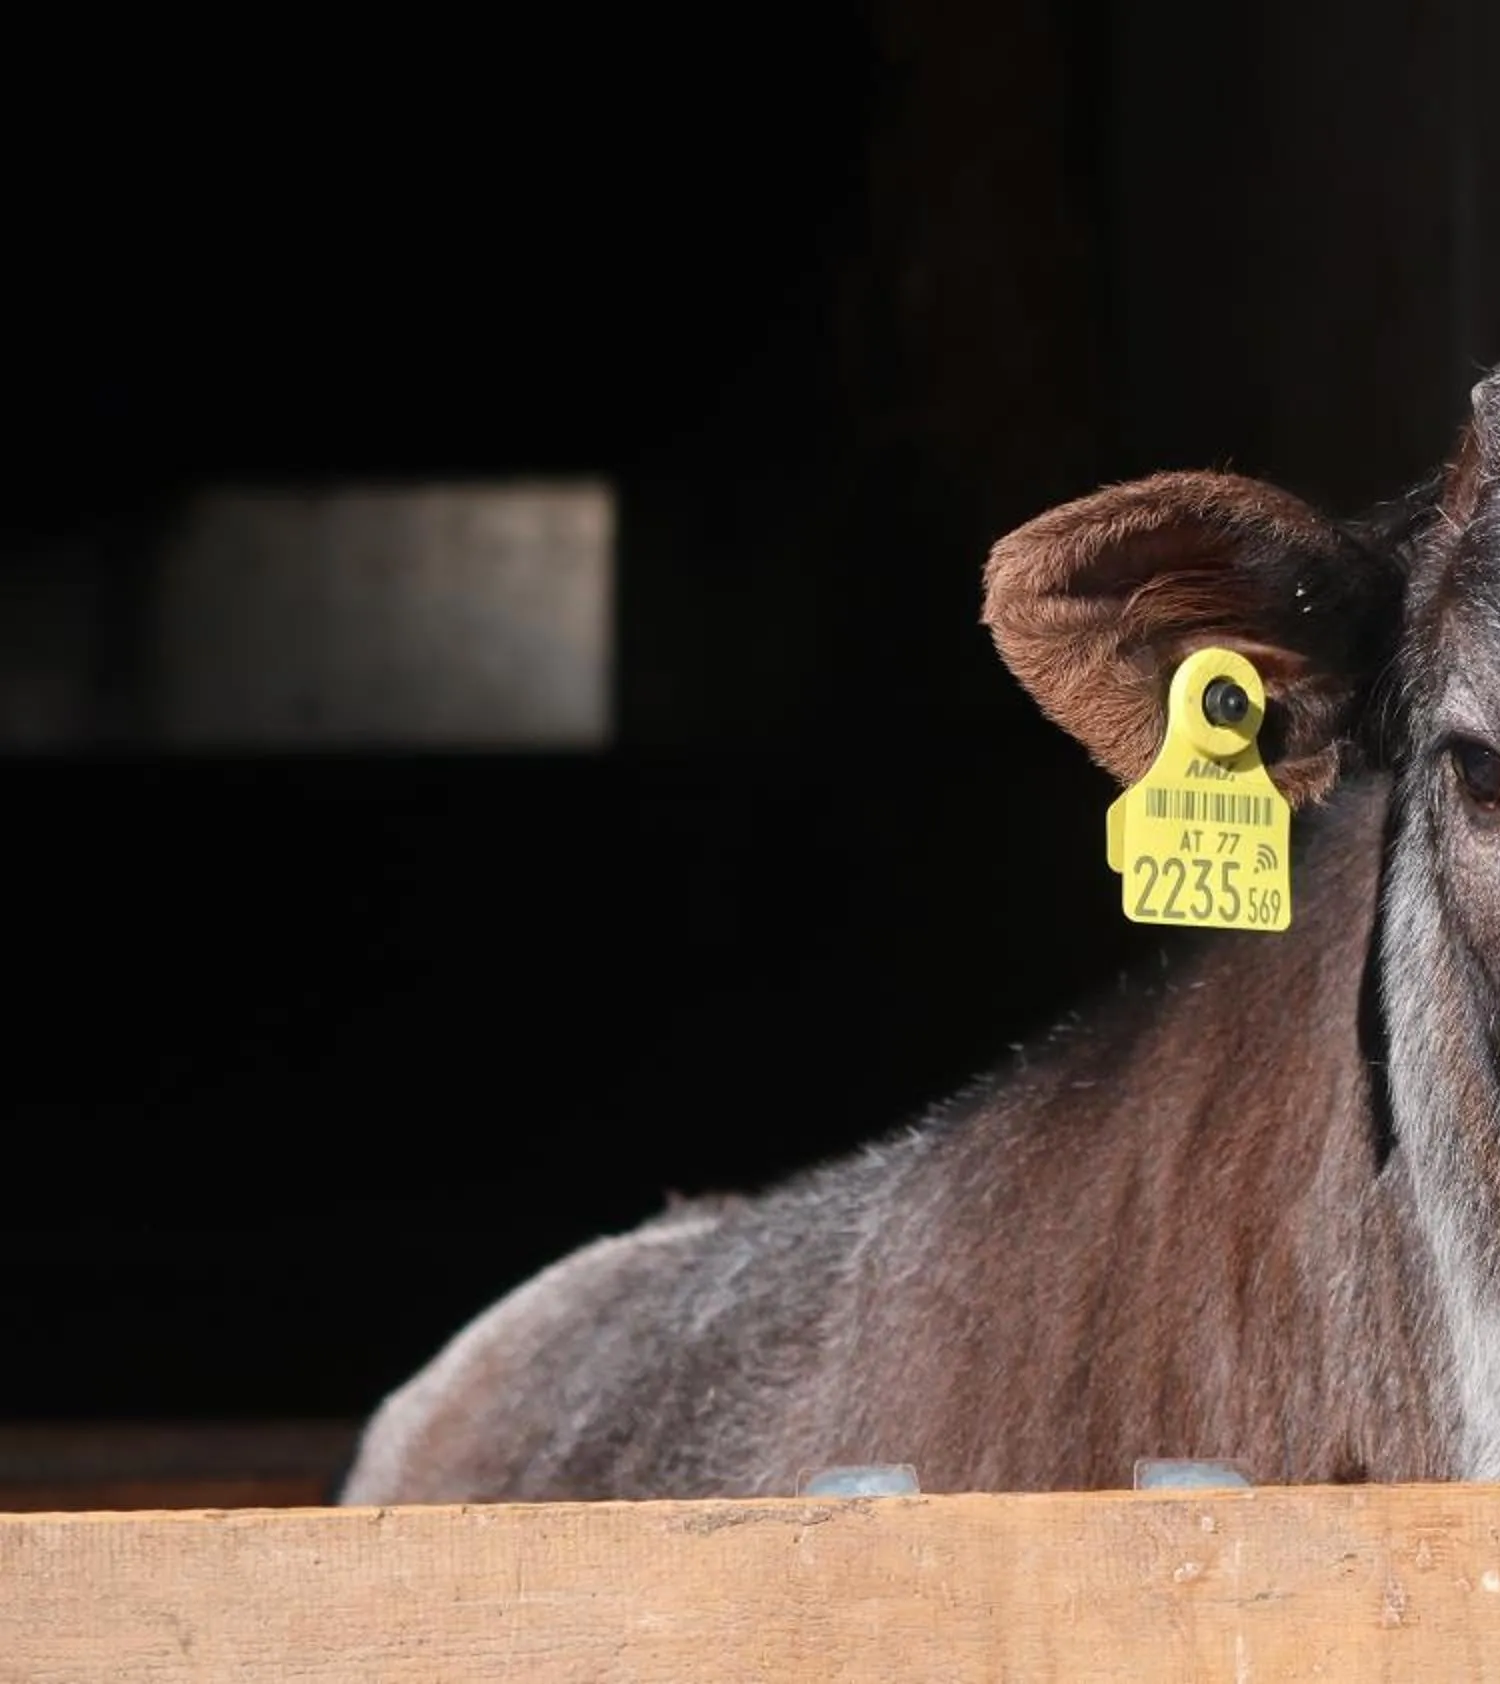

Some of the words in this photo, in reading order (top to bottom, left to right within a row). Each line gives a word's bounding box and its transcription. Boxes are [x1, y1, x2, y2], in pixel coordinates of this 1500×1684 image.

[1180, 830, 1204, 853] AT
[1217, 833, 1242, 855] 77
[1133, 855, 1242, 923] 2235
[1248, 888, 1282, 925] 569
